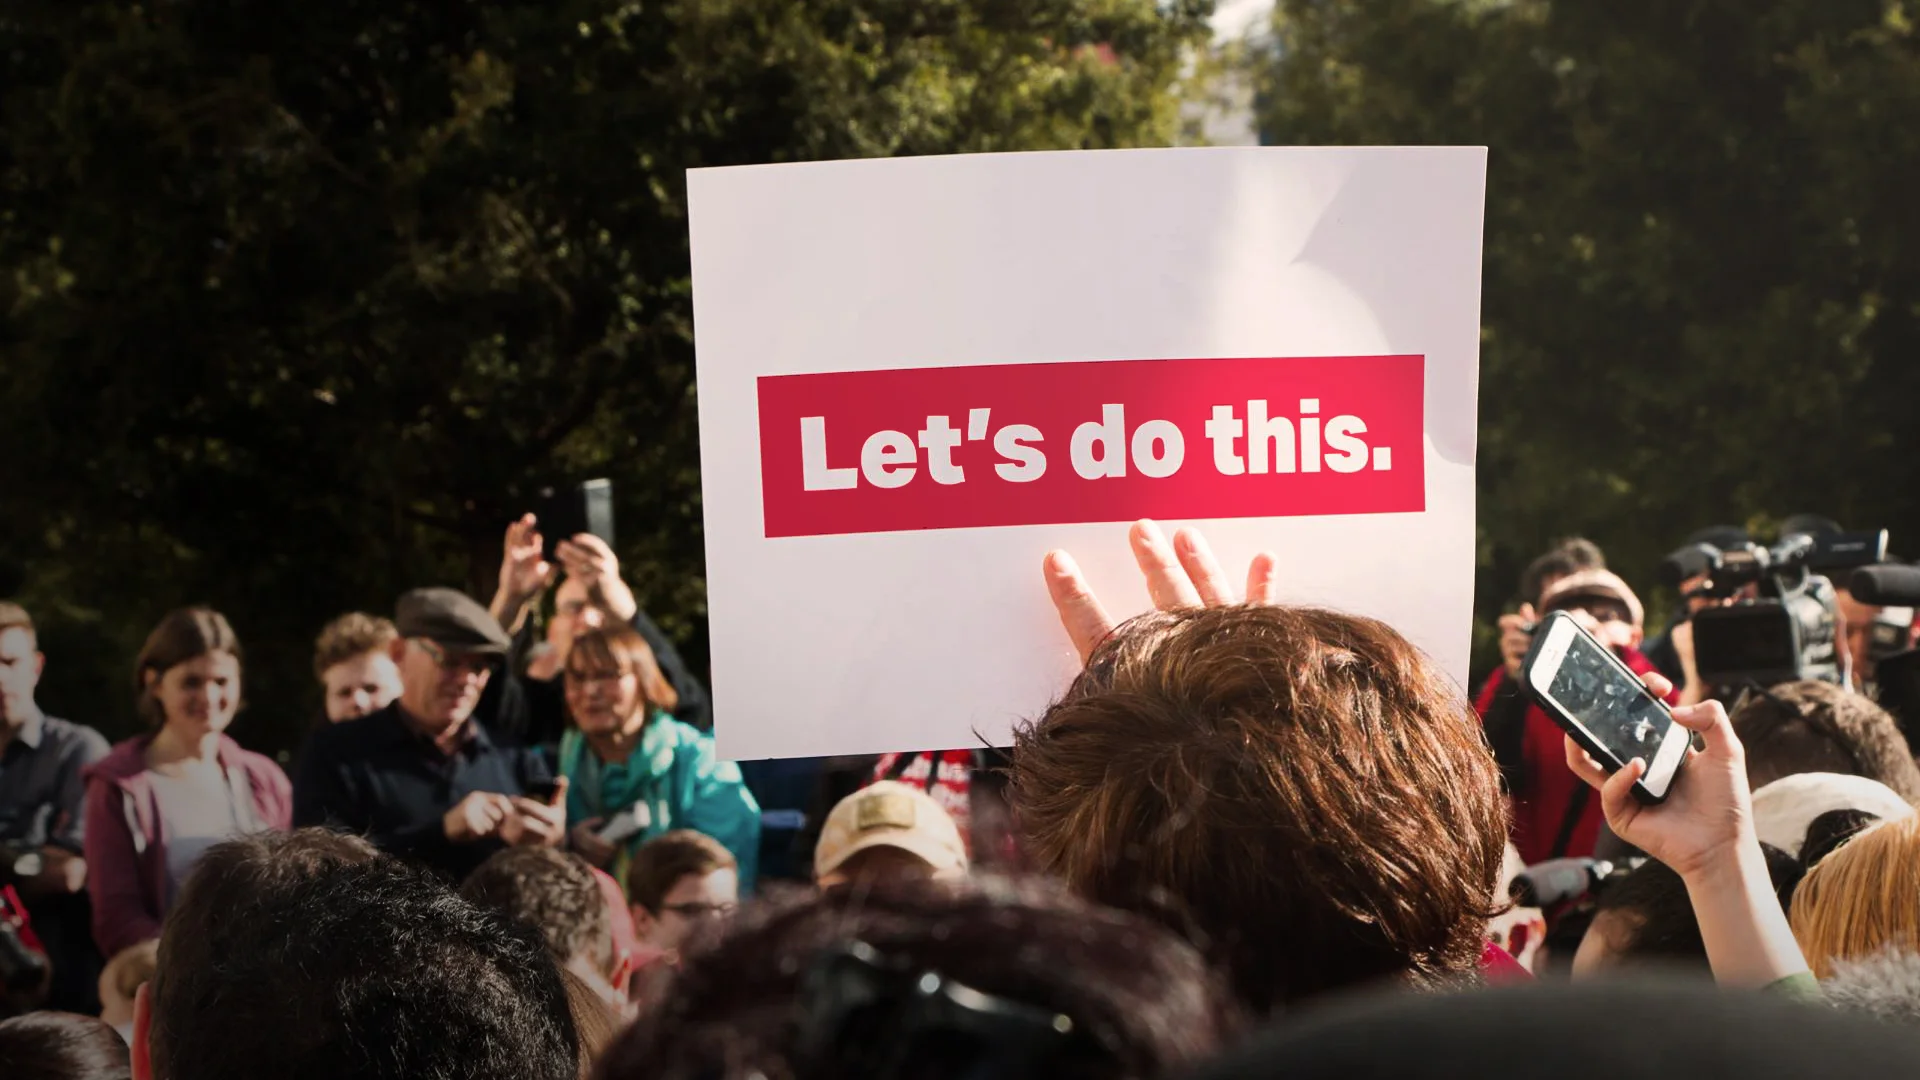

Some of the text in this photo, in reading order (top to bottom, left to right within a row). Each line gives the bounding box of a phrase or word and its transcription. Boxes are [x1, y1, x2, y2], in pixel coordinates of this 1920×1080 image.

[800, 398, 1392, 491] Let's do this.
